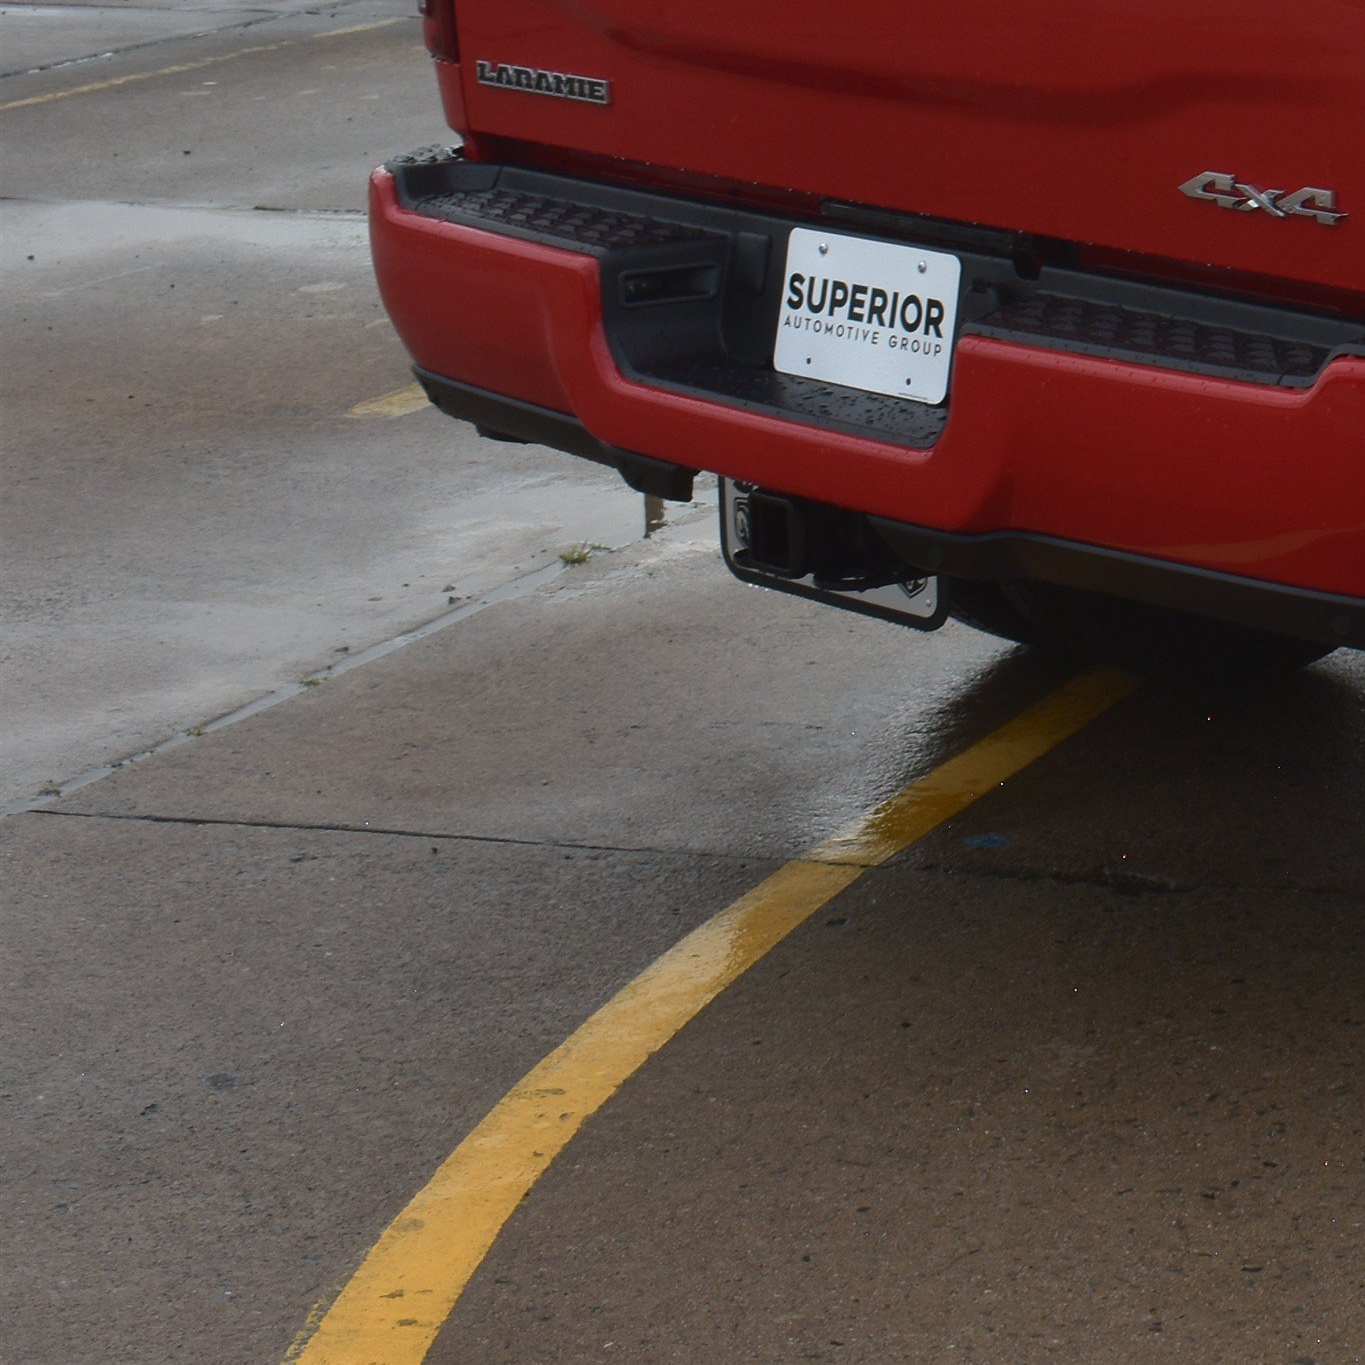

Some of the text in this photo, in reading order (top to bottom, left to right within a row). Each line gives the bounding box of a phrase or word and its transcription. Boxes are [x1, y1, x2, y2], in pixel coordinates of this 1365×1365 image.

[475, 60, 610, 105] LARAMIE
[786, 272, 945, 339] SUPERIOR
[783, 315, 942, 358] AUTOMOTIVE GROUP
